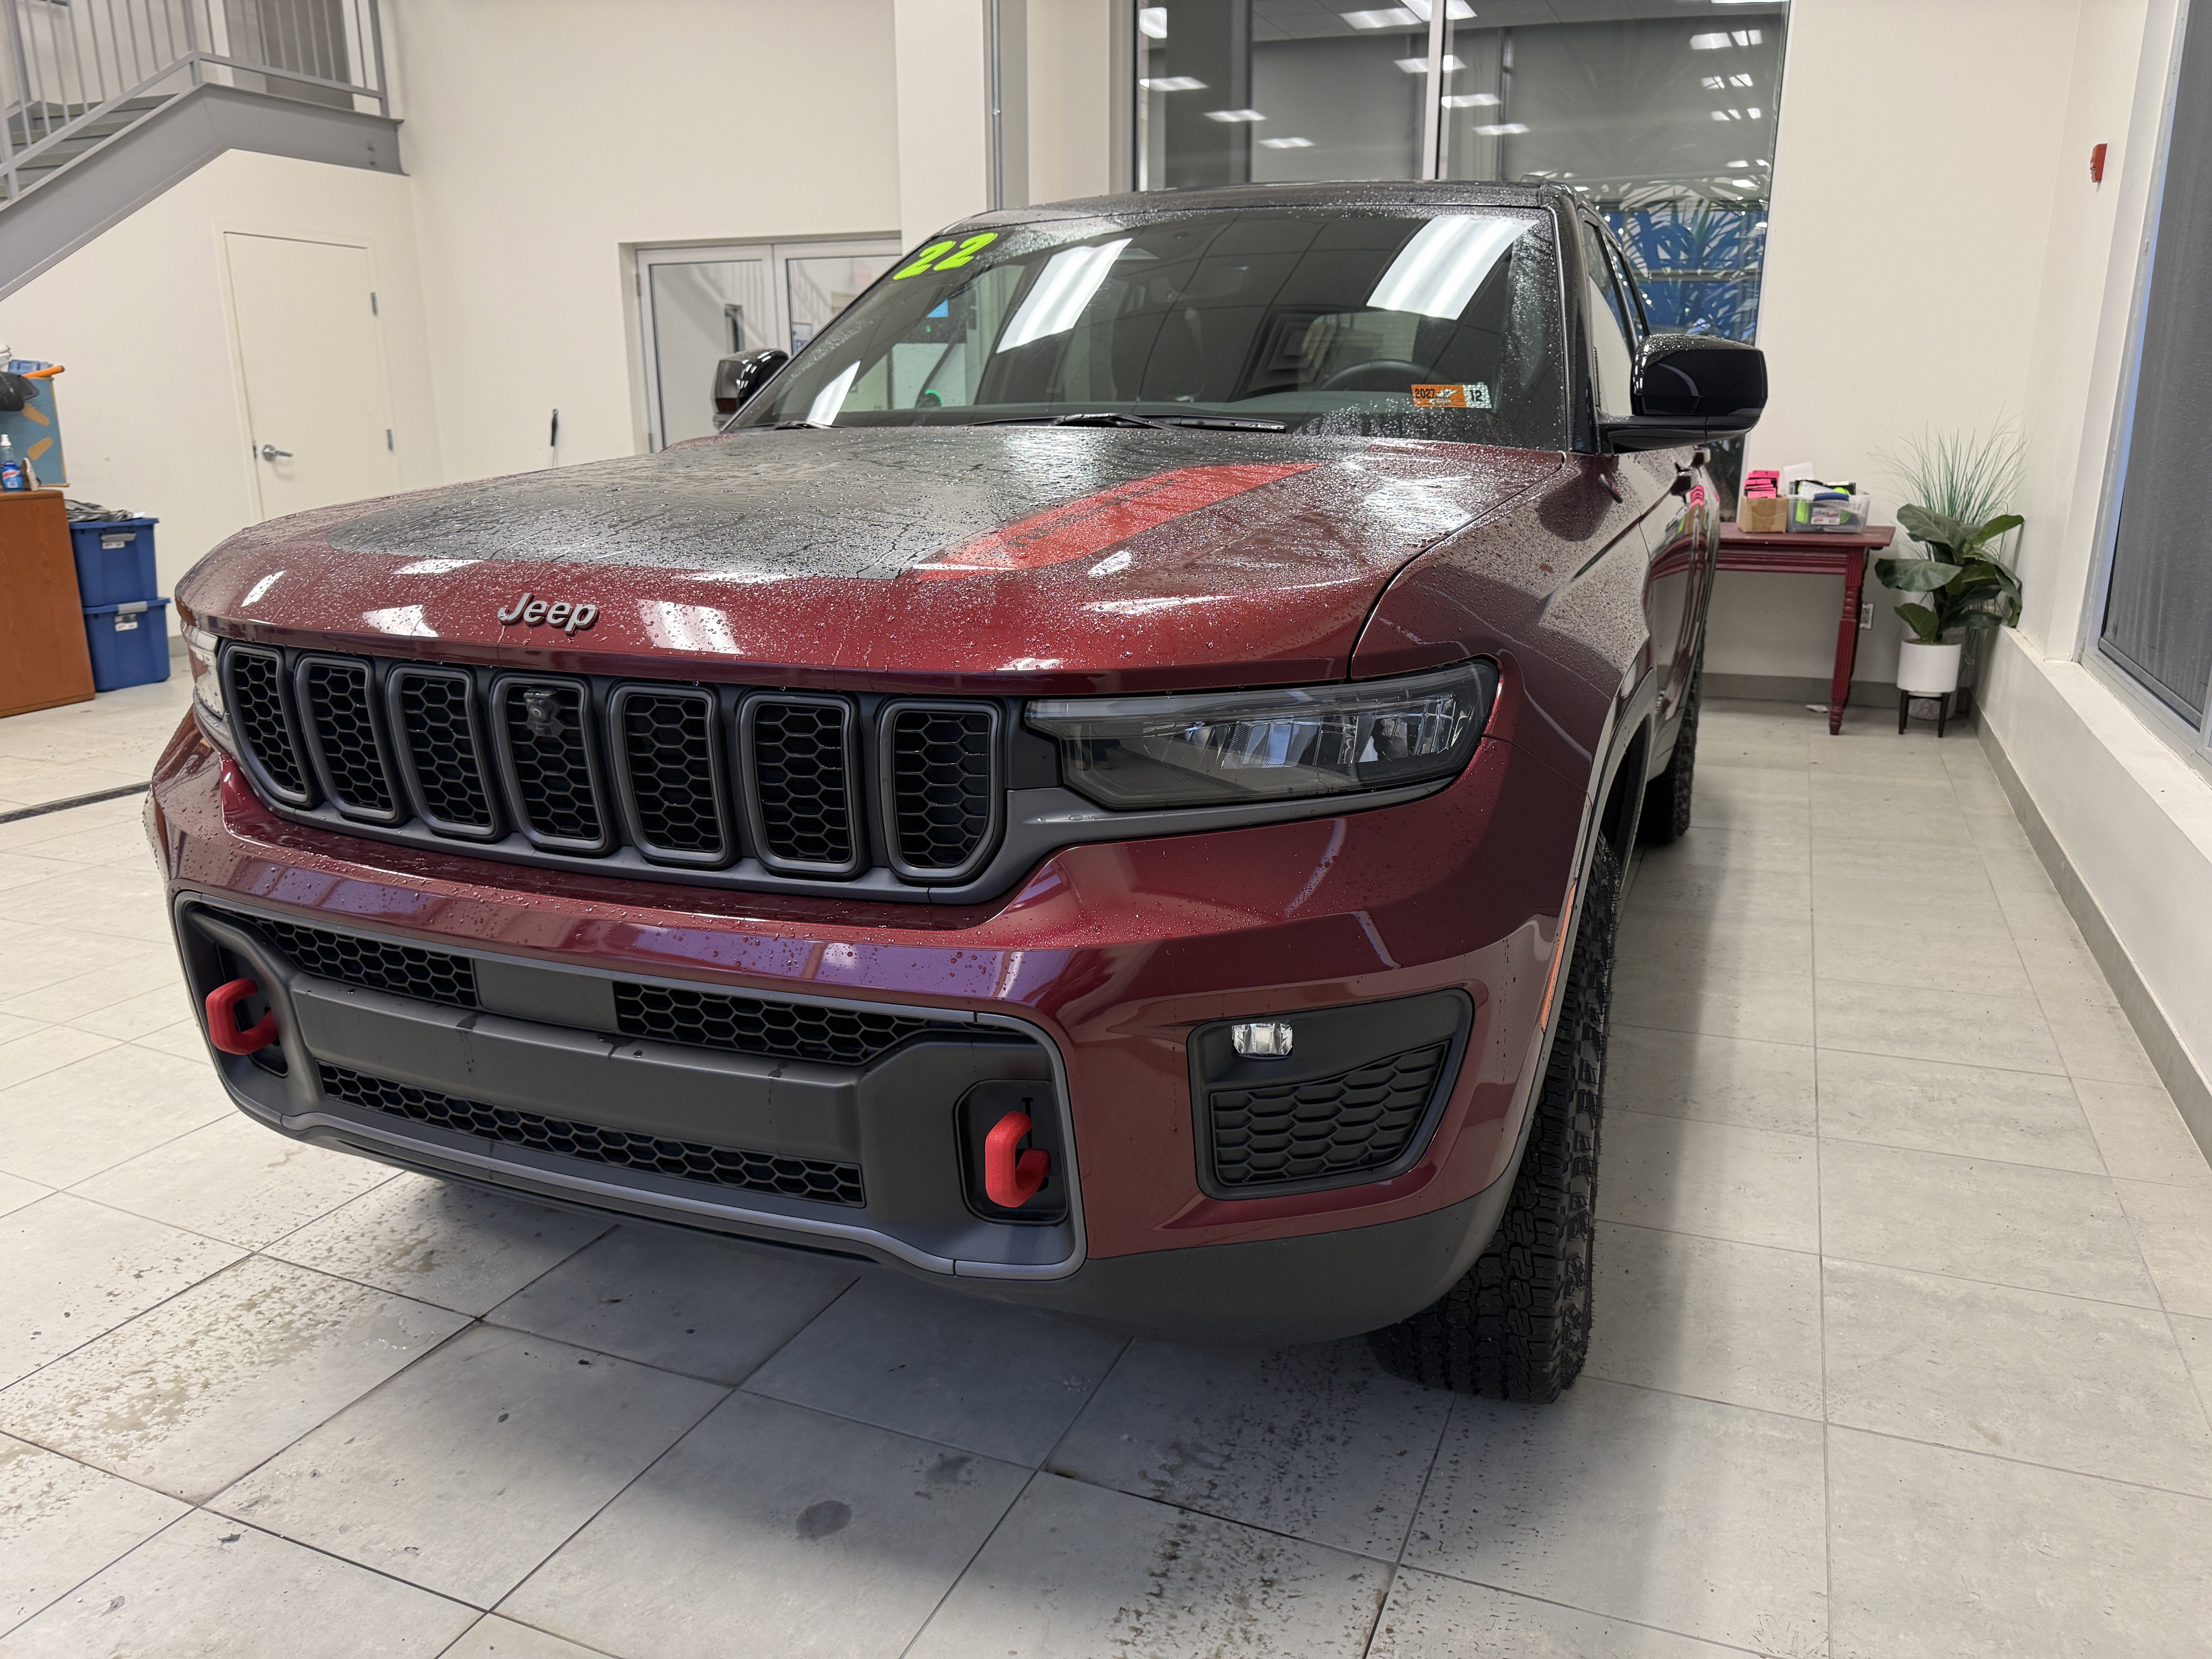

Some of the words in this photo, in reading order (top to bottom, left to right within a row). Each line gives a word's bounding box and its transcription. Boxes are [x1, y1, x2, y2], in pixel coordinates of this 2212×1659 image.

[893, 232, 998, 280] 22
[1415, 388, 1435, 399] 2027
[1470, 390, 1483, 402] 12
[498, 592, 600, 636] Jeep
